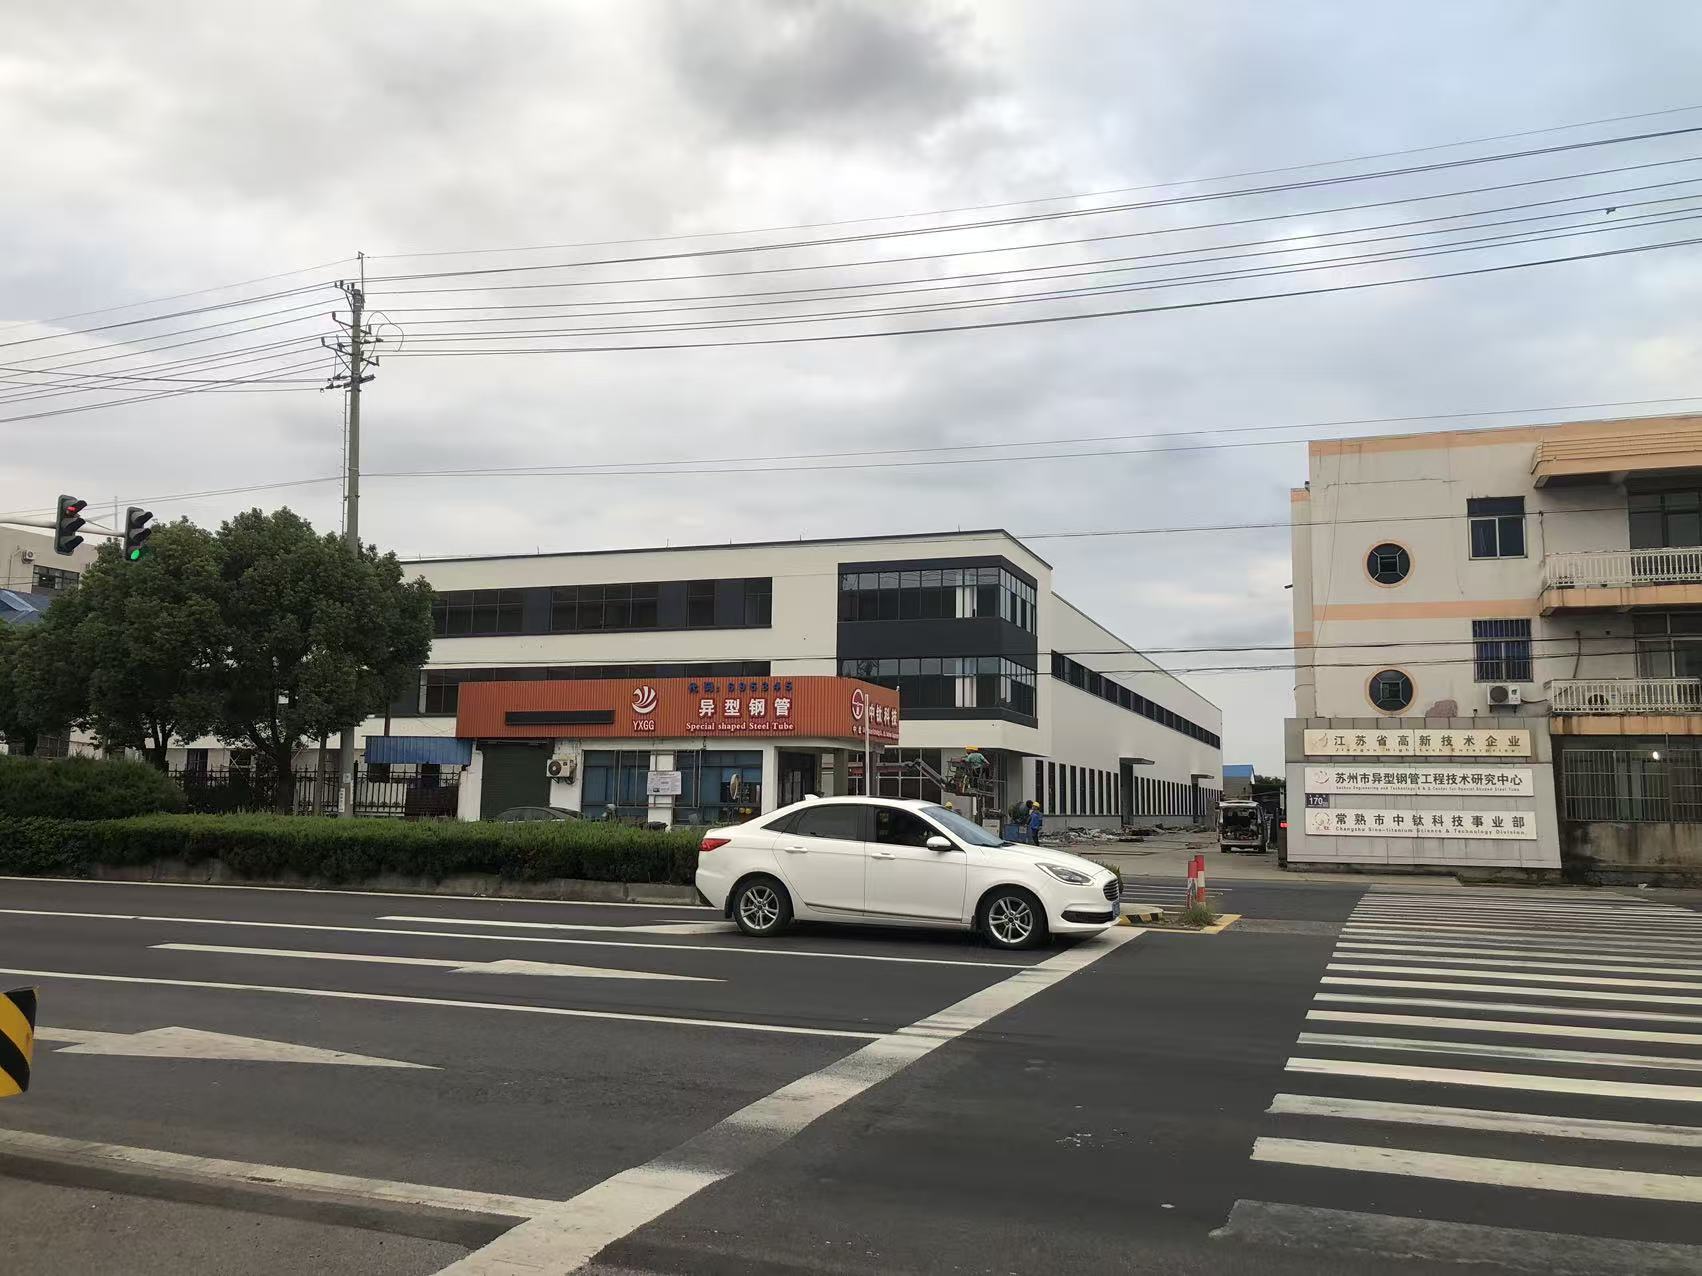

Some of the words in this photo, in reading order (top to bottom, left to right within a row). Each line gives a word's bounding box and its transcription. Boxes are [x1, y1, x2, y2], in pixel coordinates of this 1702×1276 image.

[698, 698, 791, 717] 异型钢管
[633, 720, 655, 730] YXGG
[686, 722, 715, 731] Special
[718, 722, 746, 731] shaped
[749, 722, 769, 730] Steel
[772, 722, 794, 730] Tube
[1334, 735, 1520, 747] 江苏省高新技术企业
[1335, 772, 1523, 786] 苏州市异型钢管工程技术研究中心
[1335, 812, 1525, 828] 常熟市中钛科技事业部
